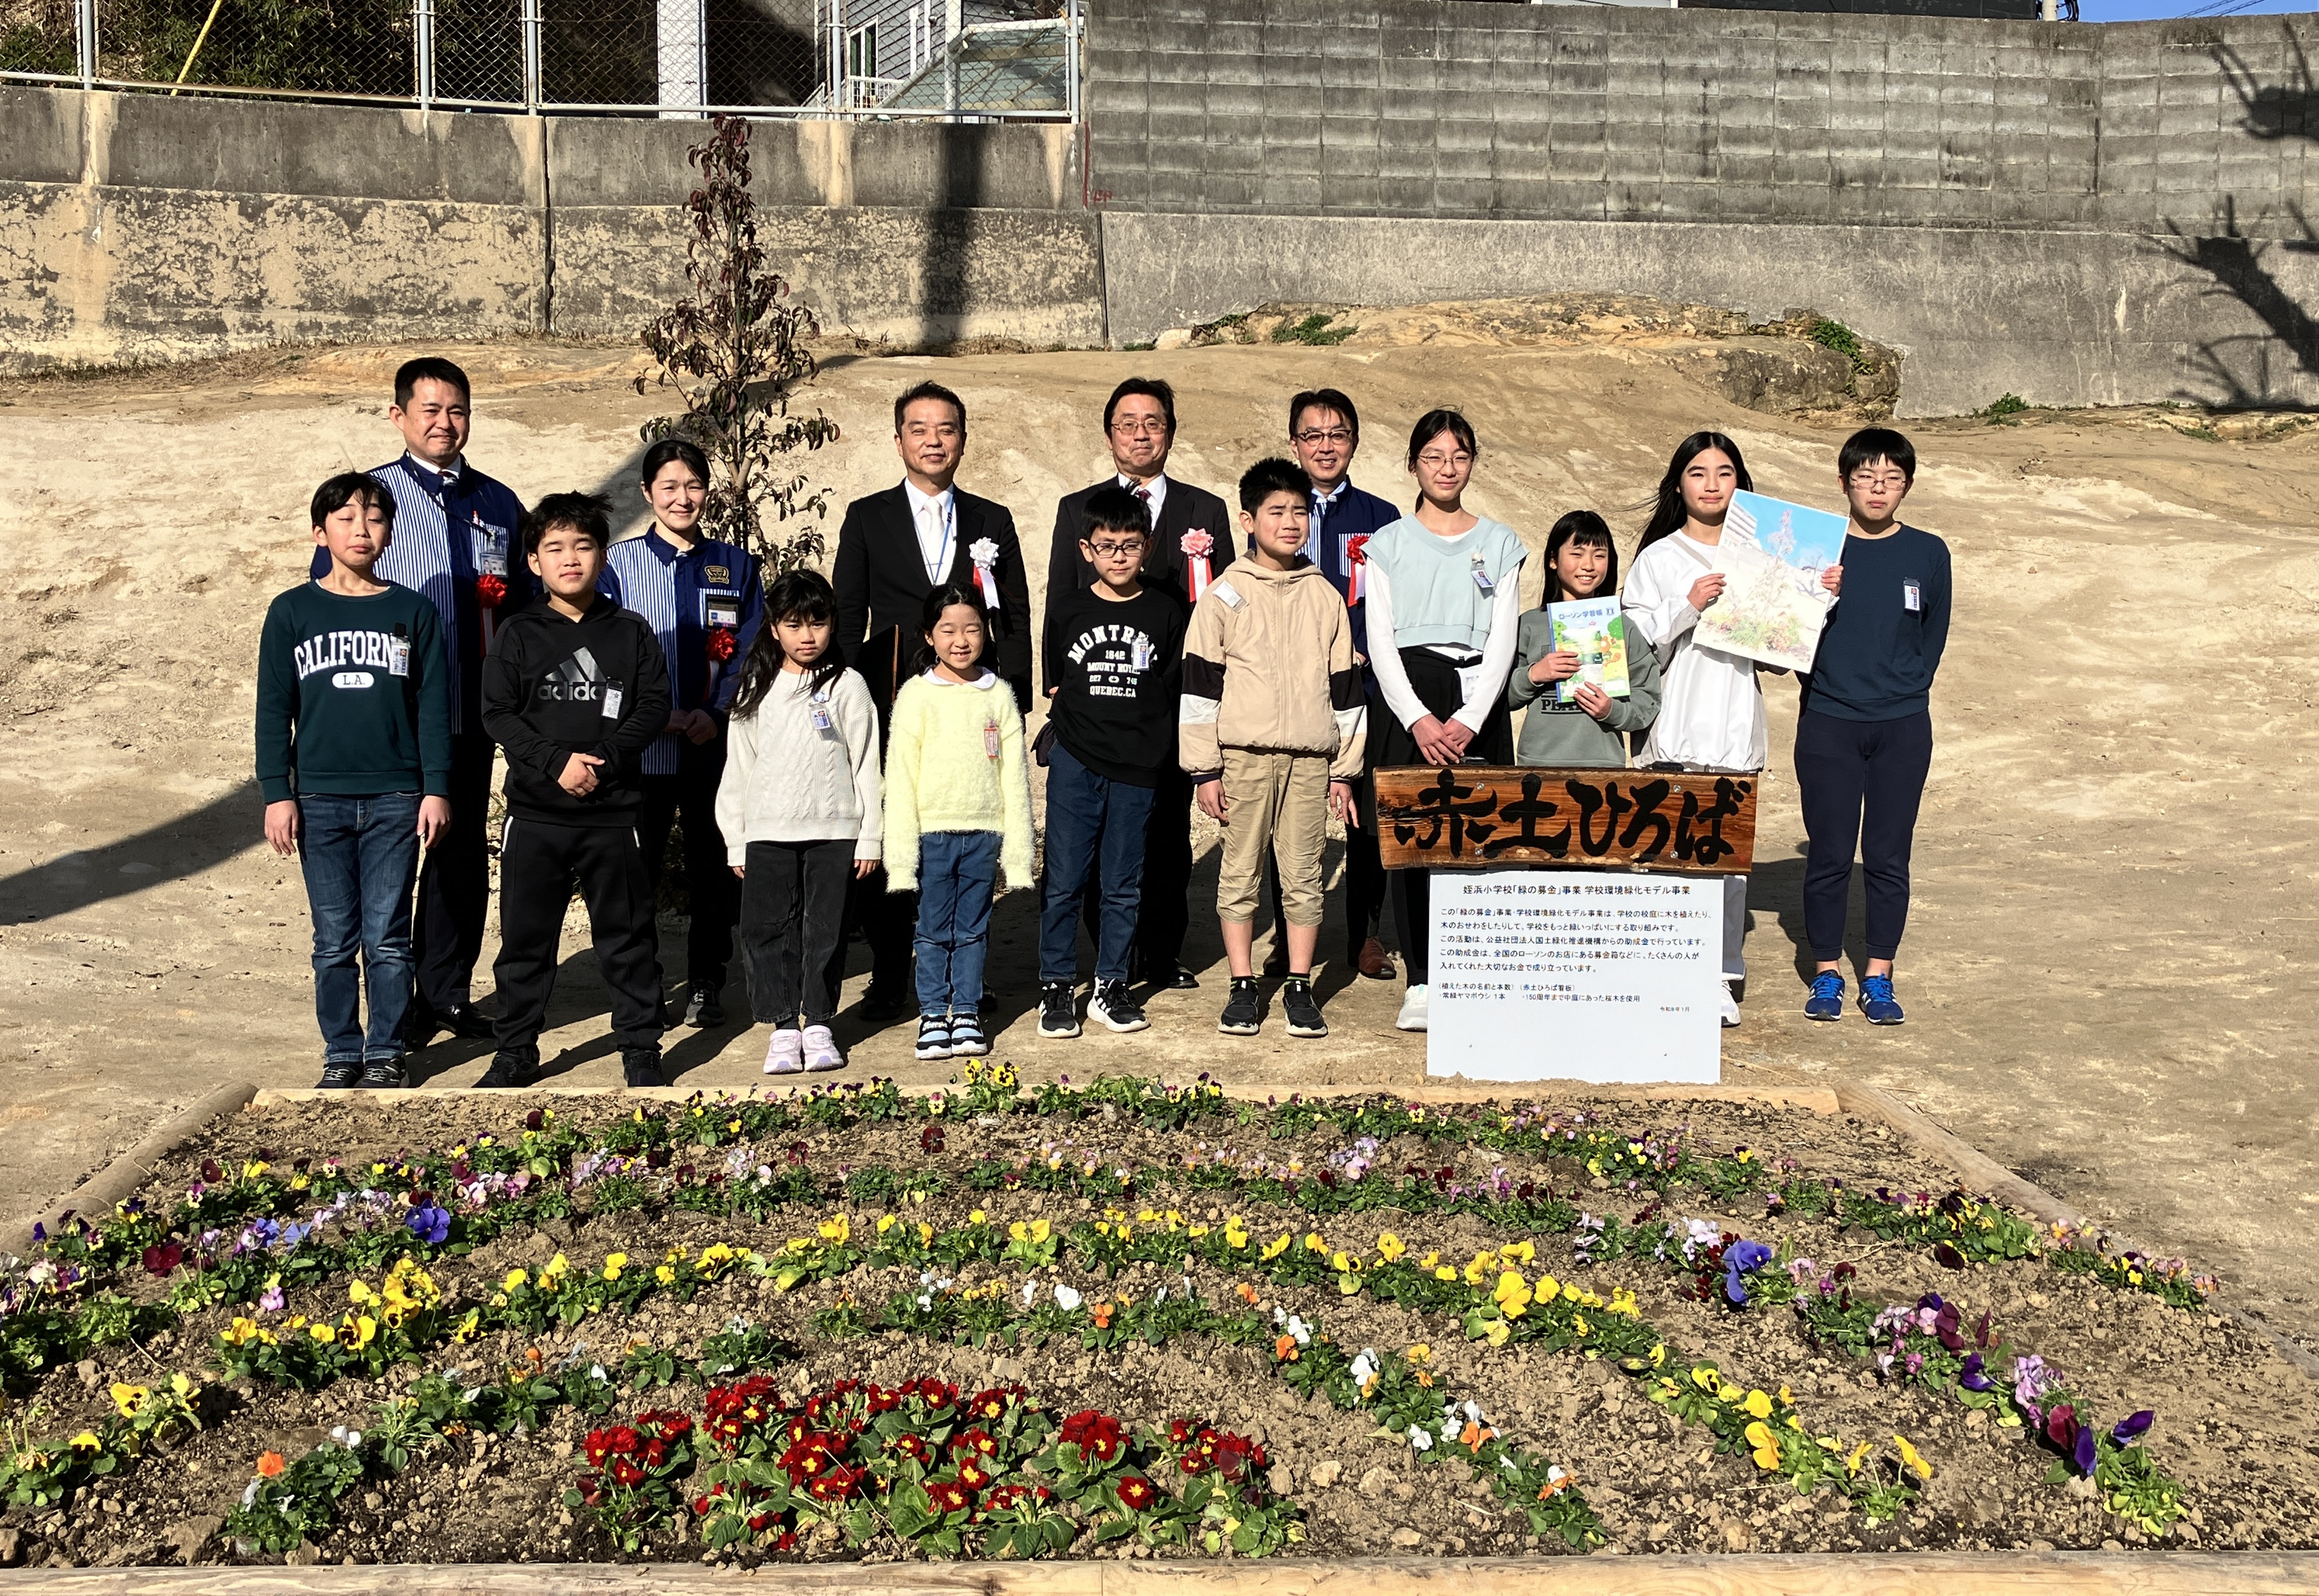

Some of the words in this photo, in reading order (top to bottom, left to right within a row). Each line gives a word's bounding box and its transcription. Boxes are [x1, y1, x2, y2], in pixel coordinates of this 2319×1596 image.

[1068, 625, 1157, 665] MONTRE
[294, 630, 392, 680] CALIFORN
[1105, 650, 1125, 660] 1642
[1087, 662, 1115, 672] MOUNT
[343, 675, 366, 686] L.A.
[537, 681, 605, 701] adida
[1090, 686, 1136, 698] QUEBEC.CA
[1388, 769, 1752, 866] 赤土ひろば
[1463, 885, 1581, 895] 姪浜小学校「緑の募金」事業
[1584, 885, 1691, 895] 学校環境緑化モデル事業
[1439, 962, 1596, 973] 入れてくれた大切なお金で成り立っています。
